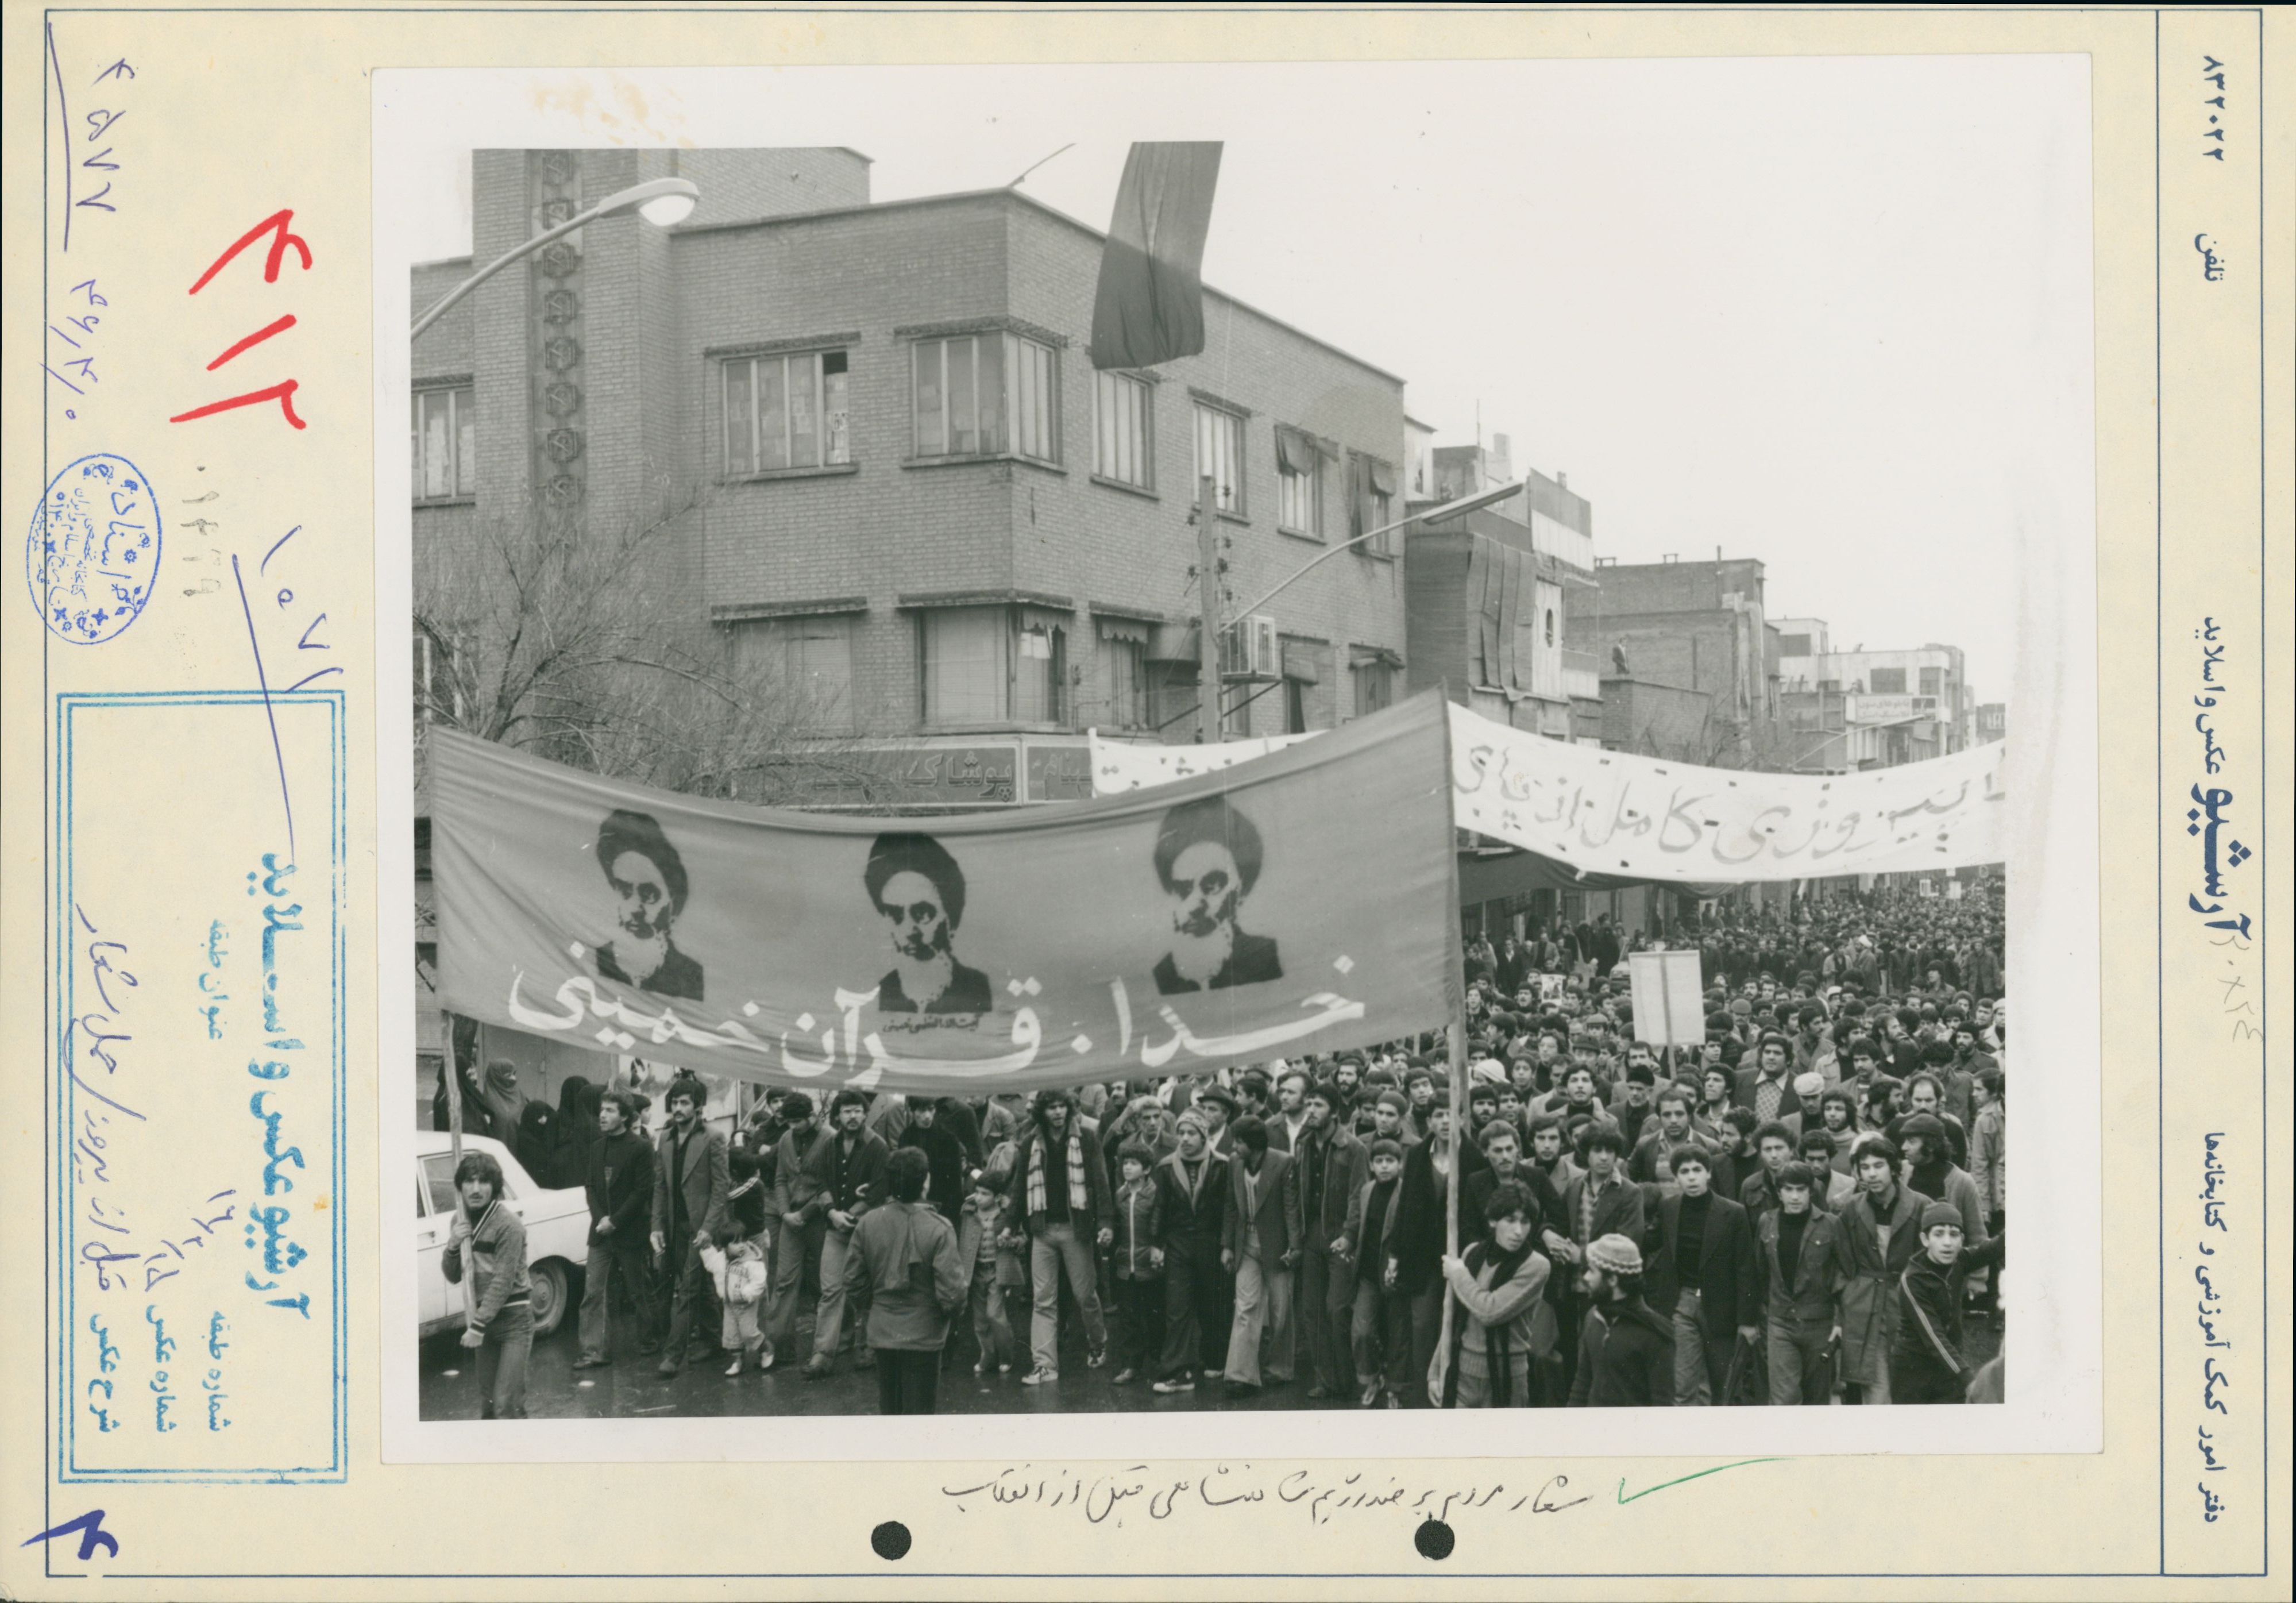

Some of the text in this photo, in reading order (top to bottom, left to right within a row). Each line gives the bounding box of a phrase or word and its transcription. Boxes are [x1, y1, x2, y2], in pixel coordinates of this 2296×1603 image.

[2203, 55, 2225, 161] ۸۳۲۰۲۲
[2194, 233, 2225, 282] تلفن
[169, 209, 312, 430] ۴۱۲
[97, 492, 146, 579] اسناد
[904, 750, 1013, 802] پوشاک
[2195, 714, 2226, 775] عکس
[1581, 779, 1715, 853] کامل
[2186, 783, 2252, 941] آرشیو
[199, 919, 229, 1040] عنوان طبقه
[508, 940, 1365, 1089] خدا قرآن خمینی
[250, 1091, 306, 1196] عکس
[245, 1202, 311, 1320] آرشیو
[2199, 1241, 2215, 1255] و
[2195, 1265, 2231, 1350] آموزشی
[89, 1314, 121, 1432] شرح عکس
[146, 1305, 177, 1432] شماره عکس
[202, 1311, 231, 1432] شماره طبقه
[2204, 1357, 2229, 1415] کمک
[2198, 1424, 2227, 1471] امور
[2198, 1481, 2225, 1523] دفتر
